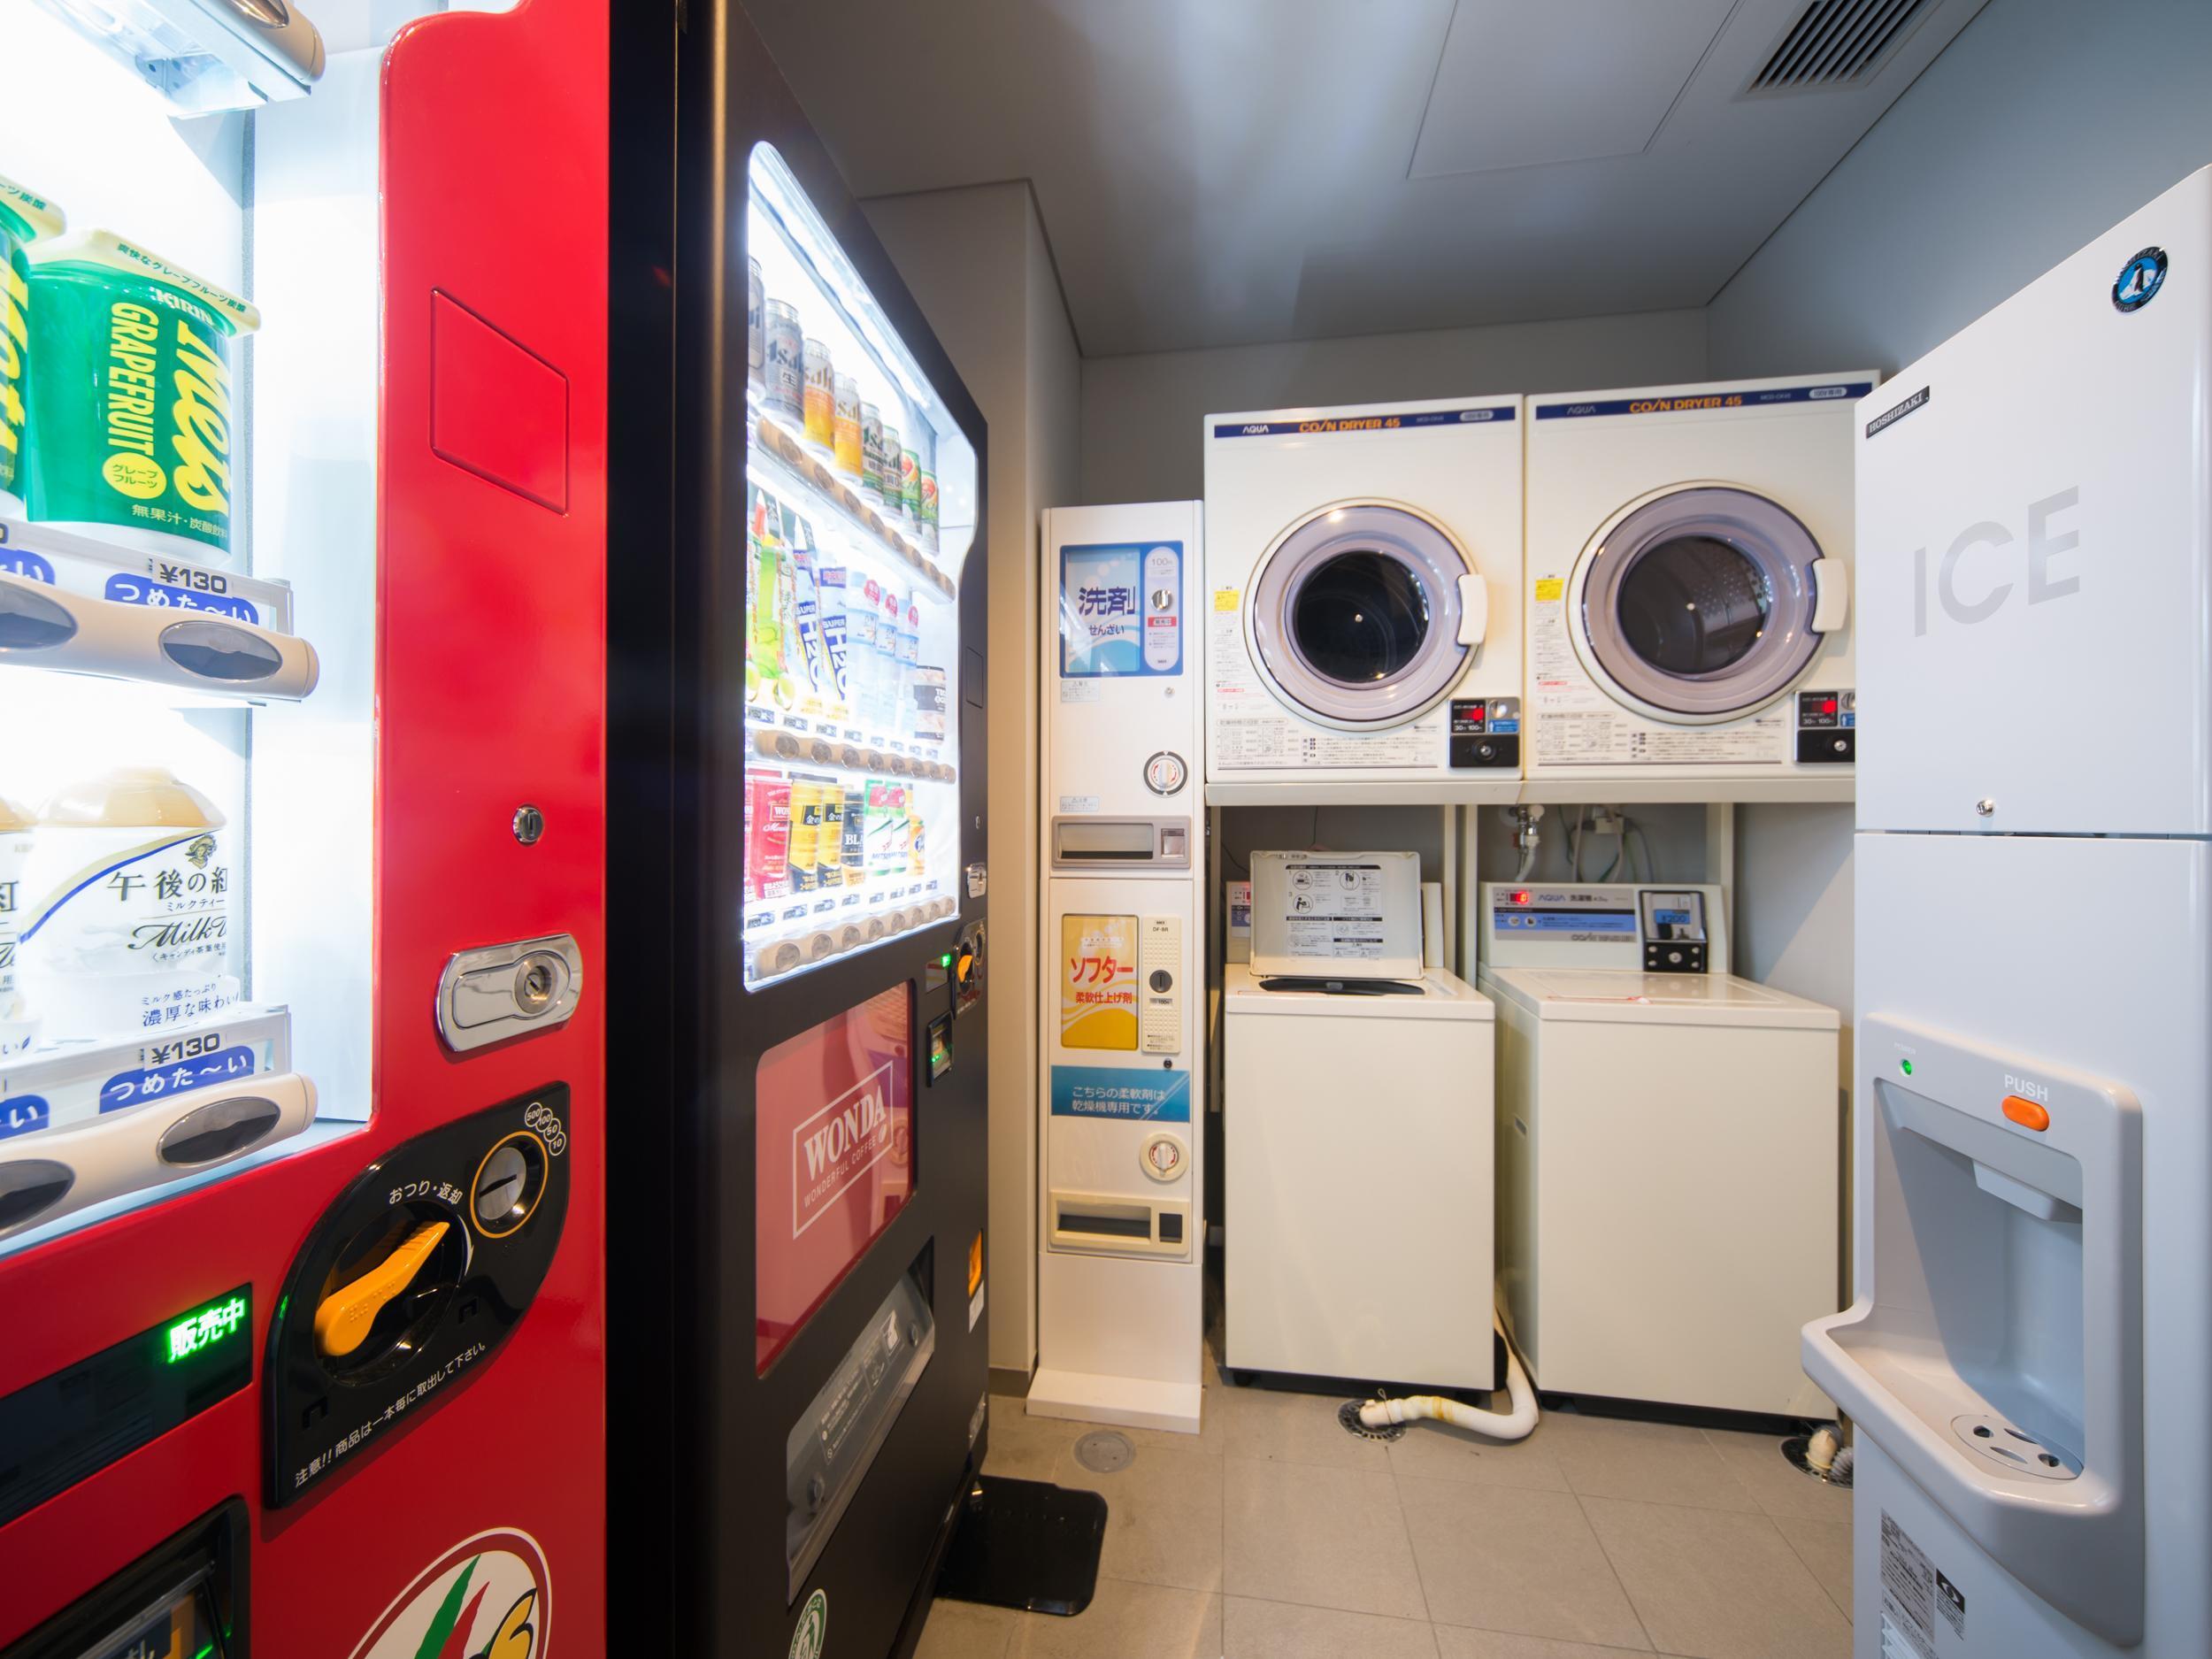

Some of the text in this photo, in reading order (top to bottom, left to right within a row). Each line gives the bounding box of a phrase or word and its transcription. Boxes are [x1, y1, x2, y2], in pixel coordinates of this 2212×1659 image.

[108, 301, 159, 457] GRAPEFRUIT
[1567, 405, 1596, 415] AQUA
[1674, 396, 1721, 411] DRYER
[1724, 395, 1742, 406] 45
[1868, 392, 1924, 434] HOSHIZAKI
[1242, 424, 1269, 434] AQUA
[1340, 418, 1382, 432] DRYER
[1385, 417, 1401, 427] 45
[1915, 485, 2080, 638] ICE
[159, 563, 227, 595] ¥130
[1079, 586, 1136, 617] 洗剤
[1089, 624, 1125, 636] せんざい
[127, 916, 212, 949] Milk
[1071, 956, 1133, 984] ソフター
[1076, 992, 1133, 1004] 柔軟仕上げ剤
[151, 1033, 221, 1064] ¥130
[1072, 1087, 1166, 1102] こちらの柔軟剤は
[2004, 1073, 2049, 1102] PUSH
[526, 1108, 541, 1123] 500
[538, 1114, 551, 1126] 100
[803, 1085, 887, 1181] WONDA
[803, 1135, 877, 1208] WONDERFUL COFFEE
[389, 1179, 463, 1205] おつり・返却
[169, 1298, 246, 1363] 販売中
